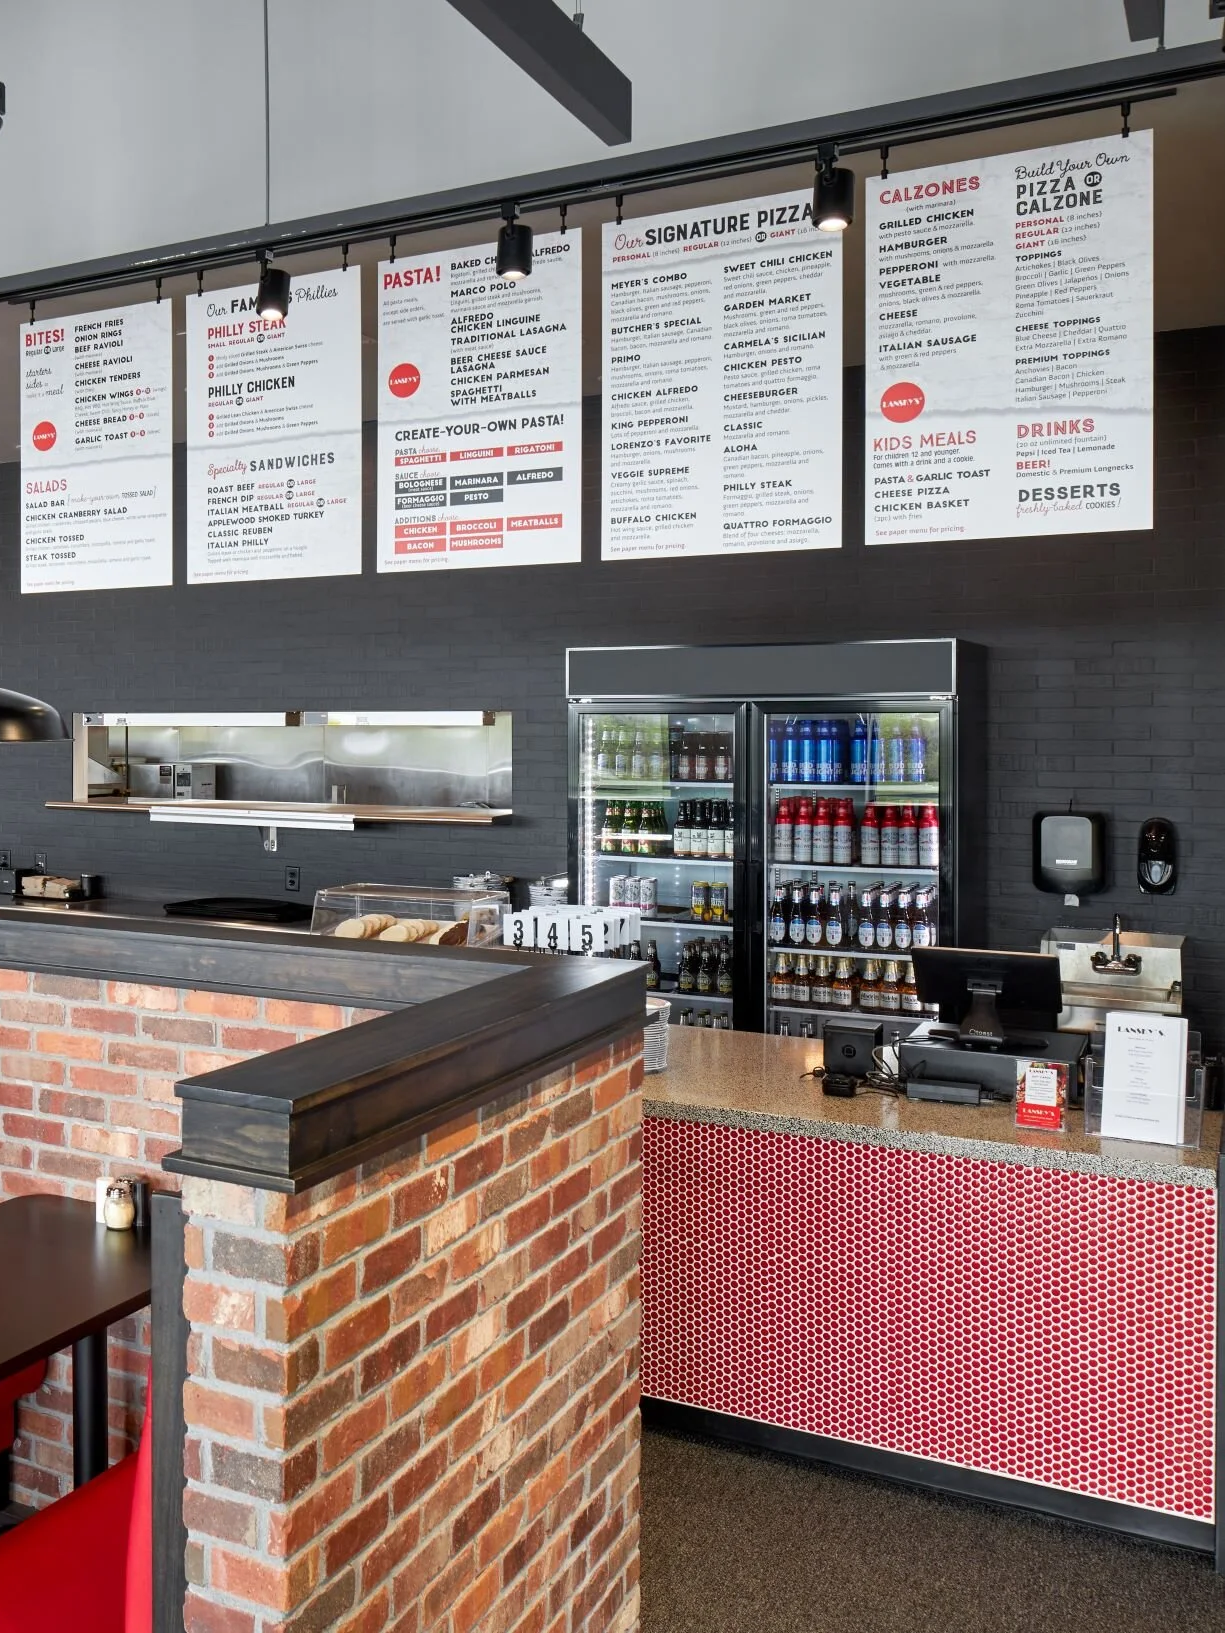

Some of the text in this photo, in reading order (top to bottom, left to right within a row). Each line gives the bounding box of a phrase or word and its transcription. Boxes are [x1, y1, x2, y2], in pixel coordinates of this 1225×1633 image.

[1015, 153, 1130, 180] Build Your Own
[880, 176, 980, 204] CALZONES
[1017, 174, 1101, 199] PIZZA OR
[1017, 189, 1102, 215] CALZONE
[880, 209, 974, 230] GRILLED CHICKEN
[1016, 216, 1064, 229] PERSONAL
[615, 233, 644, 250] Our
[645, 212, 749, 246] SIGNATURE
[1016, 227, 1059, 239] REGULAR
[612, 252, 650, 263] PERSONAL
[683, 241, 719, 252] REGULAR
[770, 229, 795, 238] GIANT
[879, 237, 947, 253] HAMBURGER
[1016, 240, 1045, 249] GIANT
[724, 250, 832, 273] SWEET CHILI CHICKEN
[1016, 251, 1061, 262] TOPPINGS
[451, 258, 481, 271] BAKED
[879, 261, 938, 275] PEPPERONI
[384, 265, 441, 290] PASTA!
[612, 273, 687, 290] MEYER'S COMBO
[879, 274, 941, 289] VEGETABLE
[451, 281, 516, 297] MARCO POLO
[207, 303, 227, 317] Our
[295, 285, 338, 302] Phillies
[724, 294, 811, 311] GARDEN MARKET
[451, 312, 493, 325] ALFREDO
[879, 309, 918, 320] CHEESE
[74, 319, 124, 332] FRENCH FRIES
[208, 317, 286, 339] PHILLY STEAK
[451, 314, 540, 333] CHICKEN LINGUINE
[612, 317, 701, 335] BUTCHER'S SPECIAL
[1016, 317, 1100, 332] CHEESE TOPPINGS
[25, 329, 64, 347] BITES!
[75, 330, 122, 342] ONION RINGS
[451, 323, 566, 346] TRADITIONAL LASAGNA
[724, 331, 826, 350] CARMELA'S SICILIAN
[75, 344, 91, 353] BEEF
[94, 340, 123, 351] RAVIOLI
[879, 334, 976, 352] ITALIAN SAUSAGE
[75, 356, 132, 369] CHEESE RAVIOLI
[451, 346, 547, 365] BEER CHEESE SAUCE
[612, 354, 640, 364] PRIMO
[1016, 349, 1110, 365] PREMIUM TOPPINGS
[451, 362, 495, 374] LASAGNA
[724, 356, 802, 372] CHICKEN PESTO
[75, 372, 140, 386] CHICKEN TENDERS
[451, 367, 549, 386] CHICKEN PARMESAN
[208, 376, 295, 398] PHILLY CHICKEN
[451, 385, 502, 397] SPAGHETTI
[612, 386, 698, 401] CHICKEN ALFREDO
[75, 390, 133, 404] CHICKEN WINGS
[451, 390, 536, 406] WITH MEATBALLS
[724, 388, 798, 402] CHEESEBURGER
[75, 415, 127, 427] CHEESE BREAD
[395, 414, 564, 442] CREATE-YOUR-OWN PASTA!
[612, 416, 688, 430] KING PEPPERONI
[724, 422, 763, 432] CLASSIC
[1017, 418, 1094, 438] DRINKS
[75, 432, 128, 444] GARLIC TOAST
[612, 435, 711, 451] LORENZO'S FAVORITE
[874, 430, 976, 451] KIDS MEALS
[395, 448, 417, 456] PASTA
[400, 444, 555, 465] SPAGHETTI LINGUINI RIGATONI
[724, 444, 757, 453] ALOHA
[1078, 444, 1115, 452] Lemonade
[208, 452, 335, 480] Specialty SANDWICHES
[1016, 460, 1050, 470] BEER!
[1060, 467, 1091, 475] Premium
[1094, 464, 1134, 473] Longnecks
[395, 472, 418, 480] SAUCE
[399, 479, 443, 489] BOLOGNESE
[455, 476, 498, 486] MARINARA
[516, 471, 553, 480] ALFREDO
[612, 467, 689, 479] VEGGIE SUPREME
[875, 476, 905, 485] PASTA
[916, 472, 952, 481] GARLIC
[957, 469, 990, 479] TOAST
[26, 479, 67, 494] SALADS
[208, 483, 255, 494] ROAST BEEF
[724, 480, 792, 492] PHILLY STEAK
[875, 486, 949, 498] CHEESE PIZZA
[1019, 483, 1120, 502] DESSERTS
[208, 497, 237, 505] FRENCH
[397, 495, 444, 505] FORMAGGIO
[464, 493, 488, 501] PESTO
[875, 499, 969, 512] CHICKEN BASKET
[26, 507, 127, 522] CHICKEN CRANBERRY SALAD
[208, 503, 284, 516] ITALIAN MEATBALL
[208, 511, 324, 527] APPLEWOOD SMOKED TURKEY
[611, 512, 696, 524] BUFFALO CHICKEN
[724, 516, 832, 530] QUATTRO FORMAGGIO
[514, 920, 523, 940] 3
[548, 923, 558, 940] 4
[582, 925, 593, 946] 5
